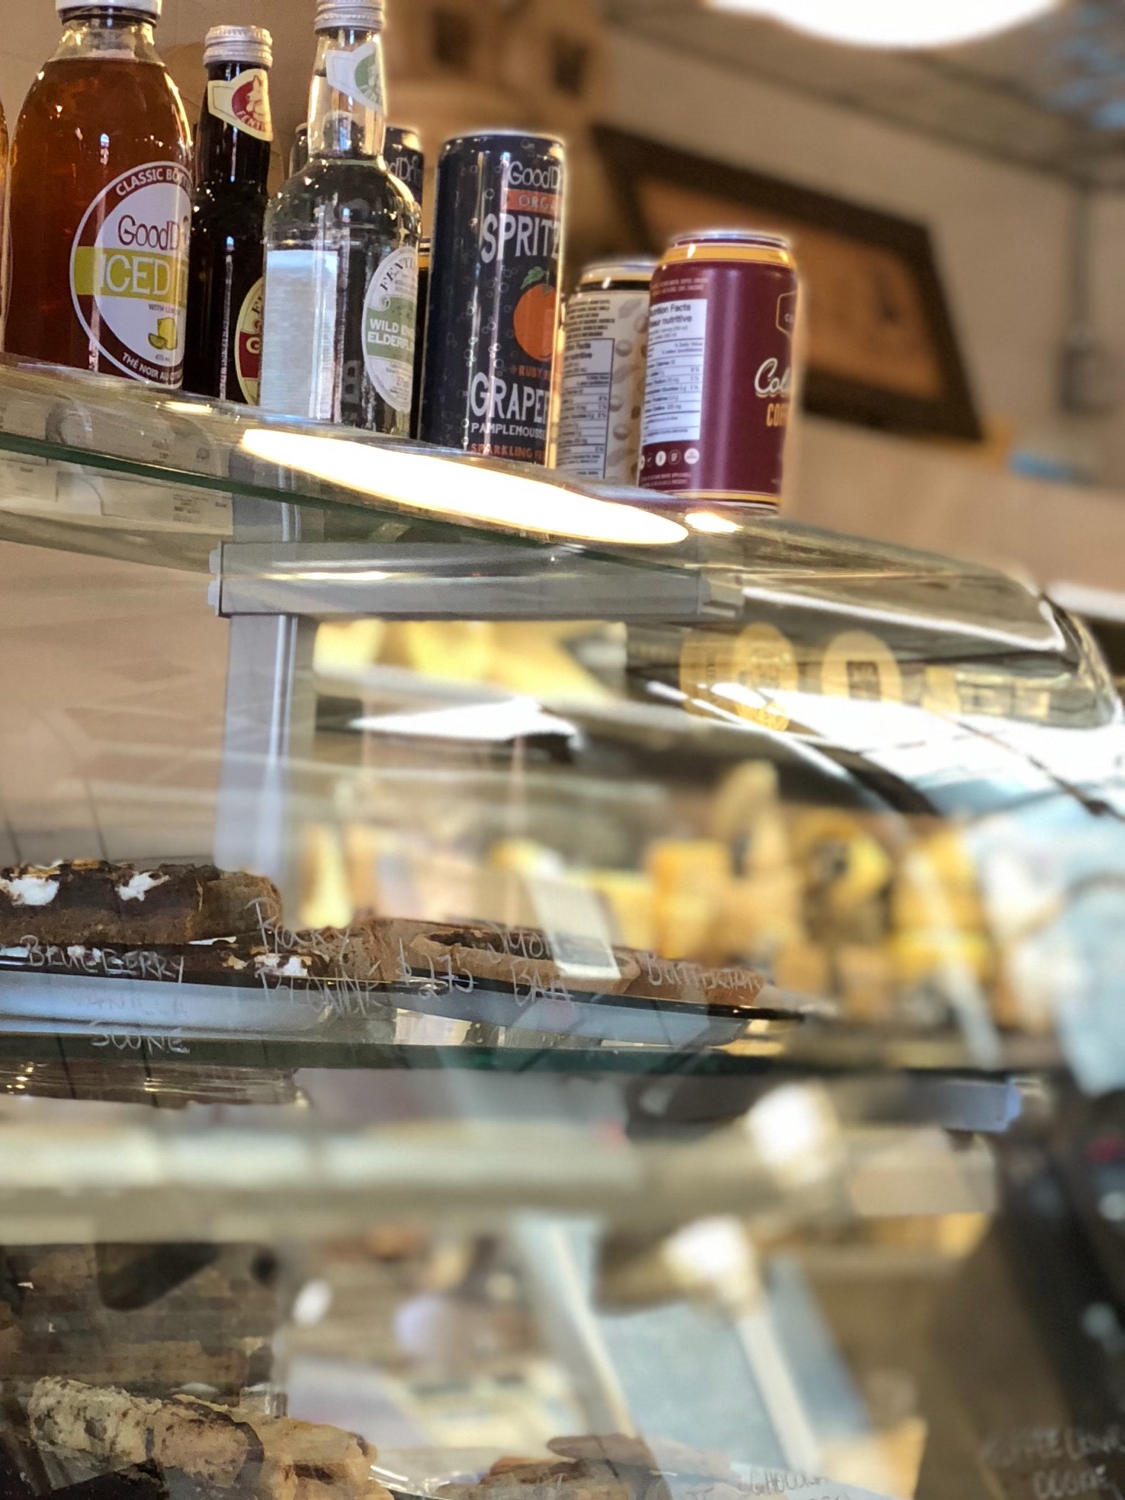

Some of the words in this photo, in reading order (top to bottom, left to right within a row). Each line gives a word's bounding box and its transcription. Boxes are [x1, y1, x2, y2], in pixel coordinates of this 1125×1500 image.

[115, 168, 164, 197] CLASSIC
[98, 253, 172, 296] ICED
[148, 303, 165, 311] WITH
[670, 303, 691, 312] Facts
[369, 318, 400, 334] WILD
[122, 352, 139, 369] THÉ
[139, 363, 159, 379] NOIR
[470, 443, 532, 459] SPARKLING
